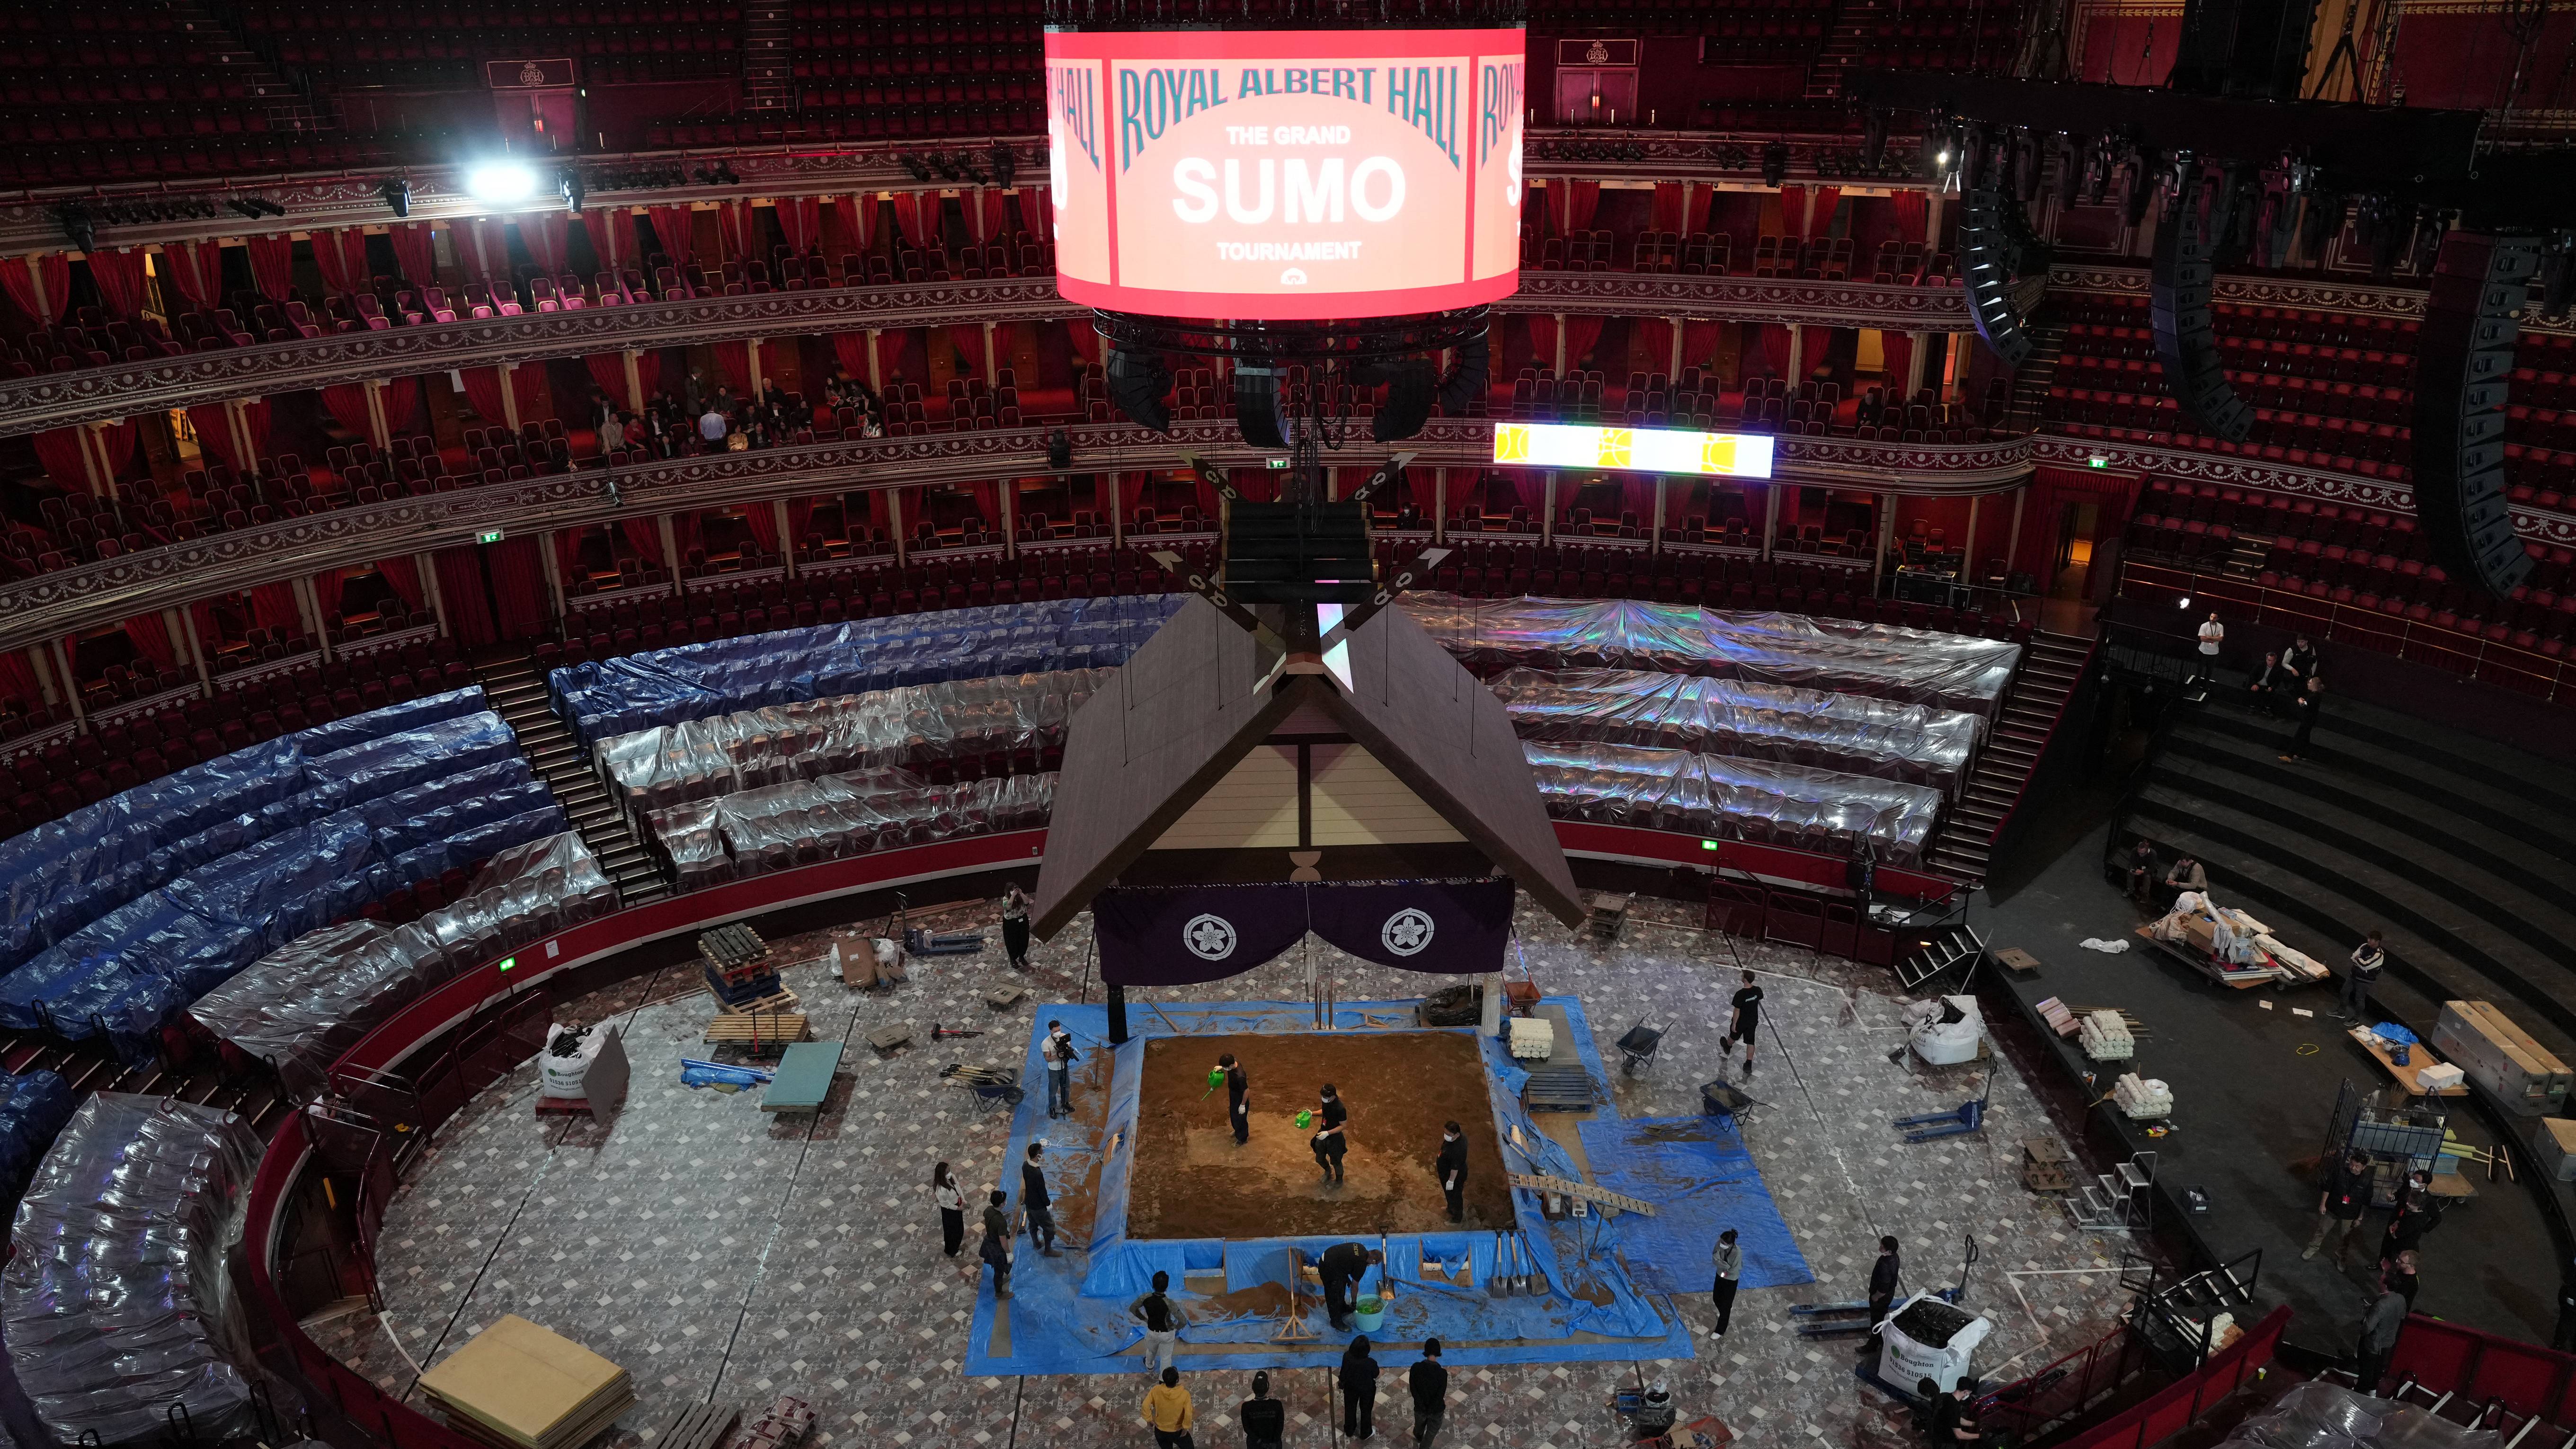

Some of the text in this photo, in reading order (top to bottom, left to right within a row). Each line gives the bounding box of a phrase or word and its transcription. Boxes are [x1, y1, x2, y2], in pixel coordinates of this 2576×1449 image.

[1056, 68, 1101, 174] HALL
[1119, 66, 1460, 175] ROYAL ALBERT HALL
[1226, 125, 1351, 145] THE GRAND
[1172, 156, 1406, 224] SUMO
[1217, 241, 1362, 260] TOURNAMENT
[550, 1077, 564, 1085] 01536
[1890, 1356, 1932, 1378] 01536 510515
[1900, 1353, 1934, 1368] Boughton
